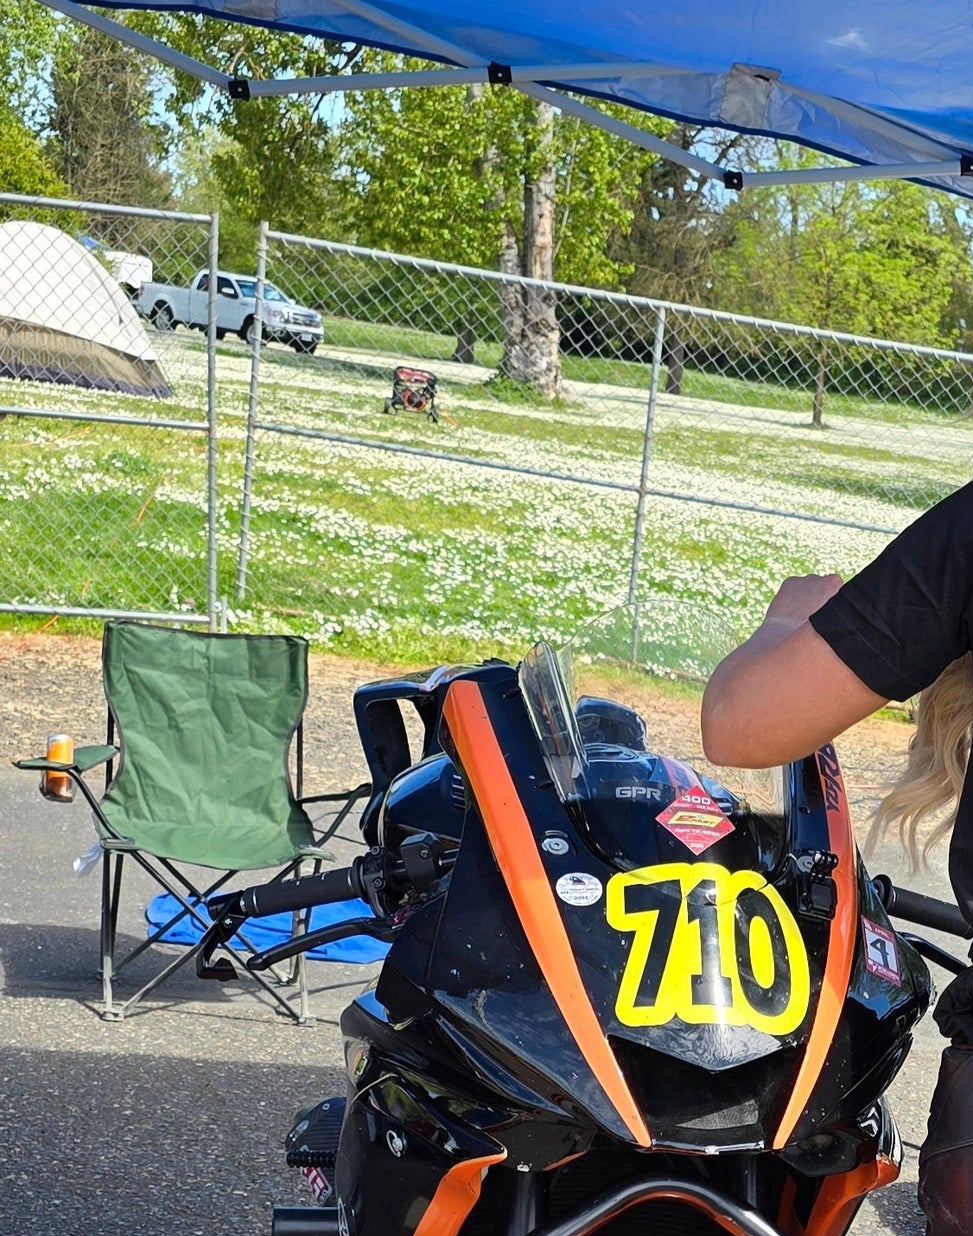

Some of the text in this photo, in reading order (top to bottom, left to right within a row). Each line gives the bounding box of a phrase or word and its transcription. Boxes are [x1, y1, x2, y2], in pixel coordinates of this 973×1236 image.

[615, 786, 661, 800] GPR
[681, 794, 711, 805] 400
[620, 875, 796, 1020] 710
[869, 938, 889, 969] 4
